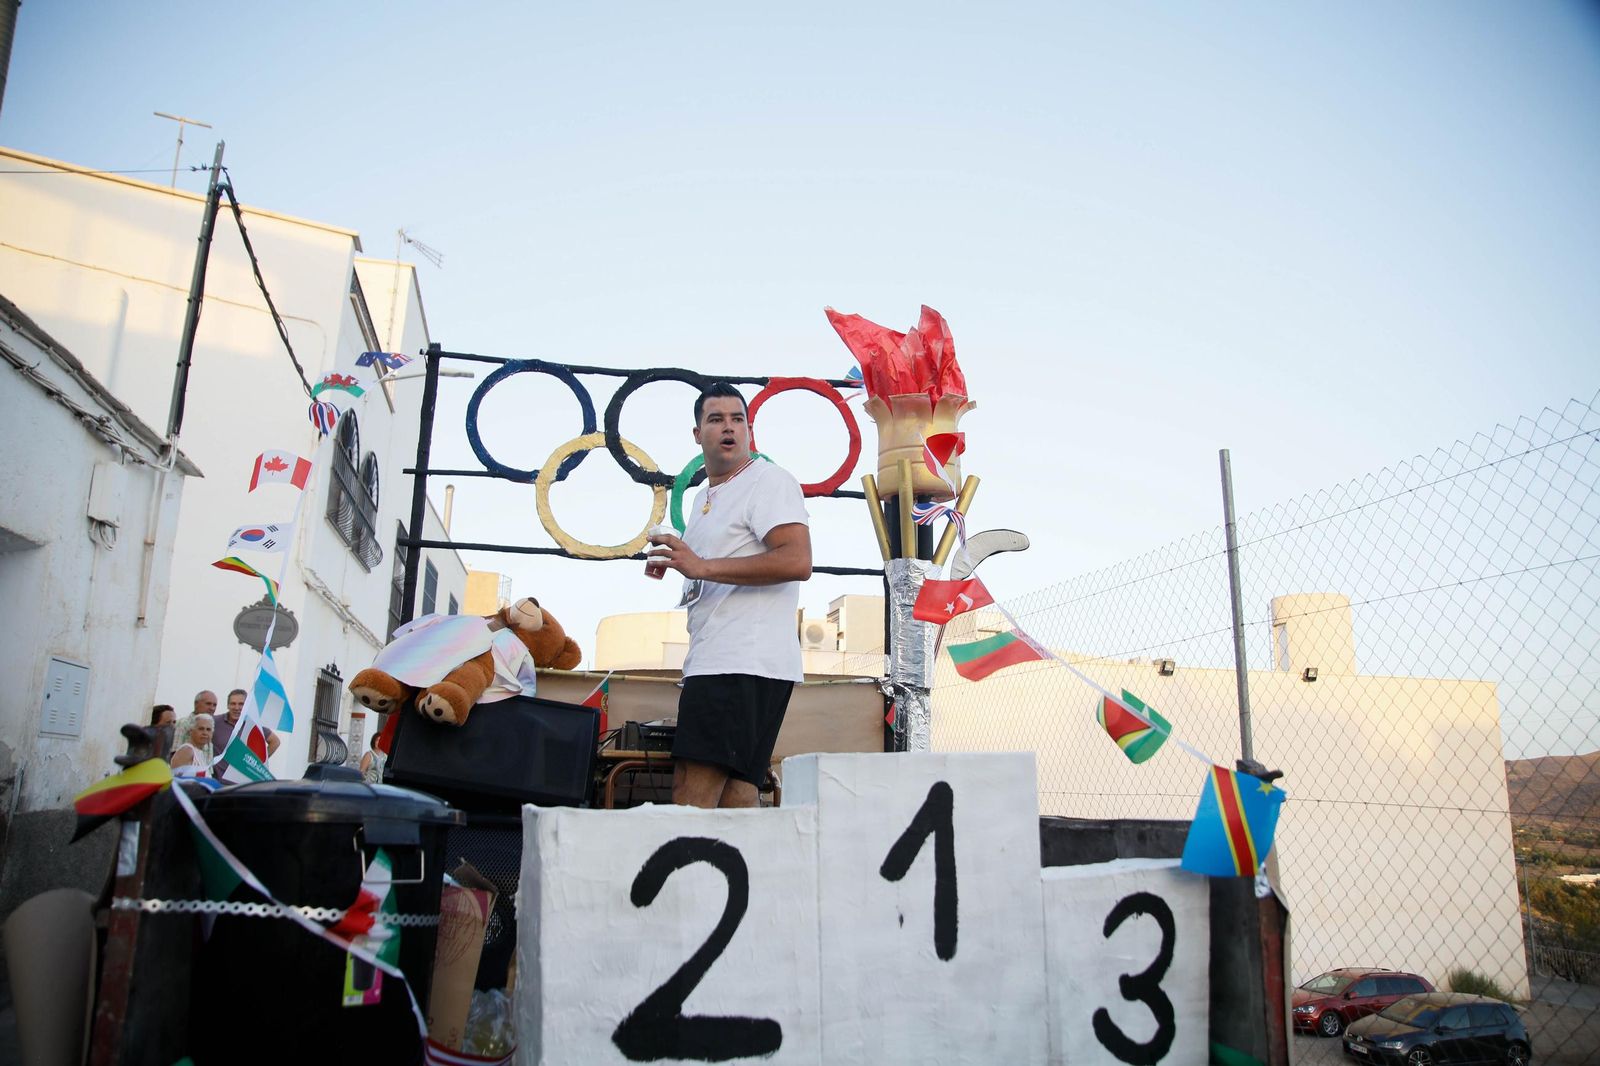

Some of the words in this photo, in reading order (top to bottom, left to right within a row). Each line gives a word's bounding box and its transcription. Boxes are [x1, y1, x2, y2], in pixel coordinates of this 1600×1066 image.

[612, 837, 782, 1062] 2
[880, 782, 958, 961] 1
[1093, 892, 1176, 1065] 3
